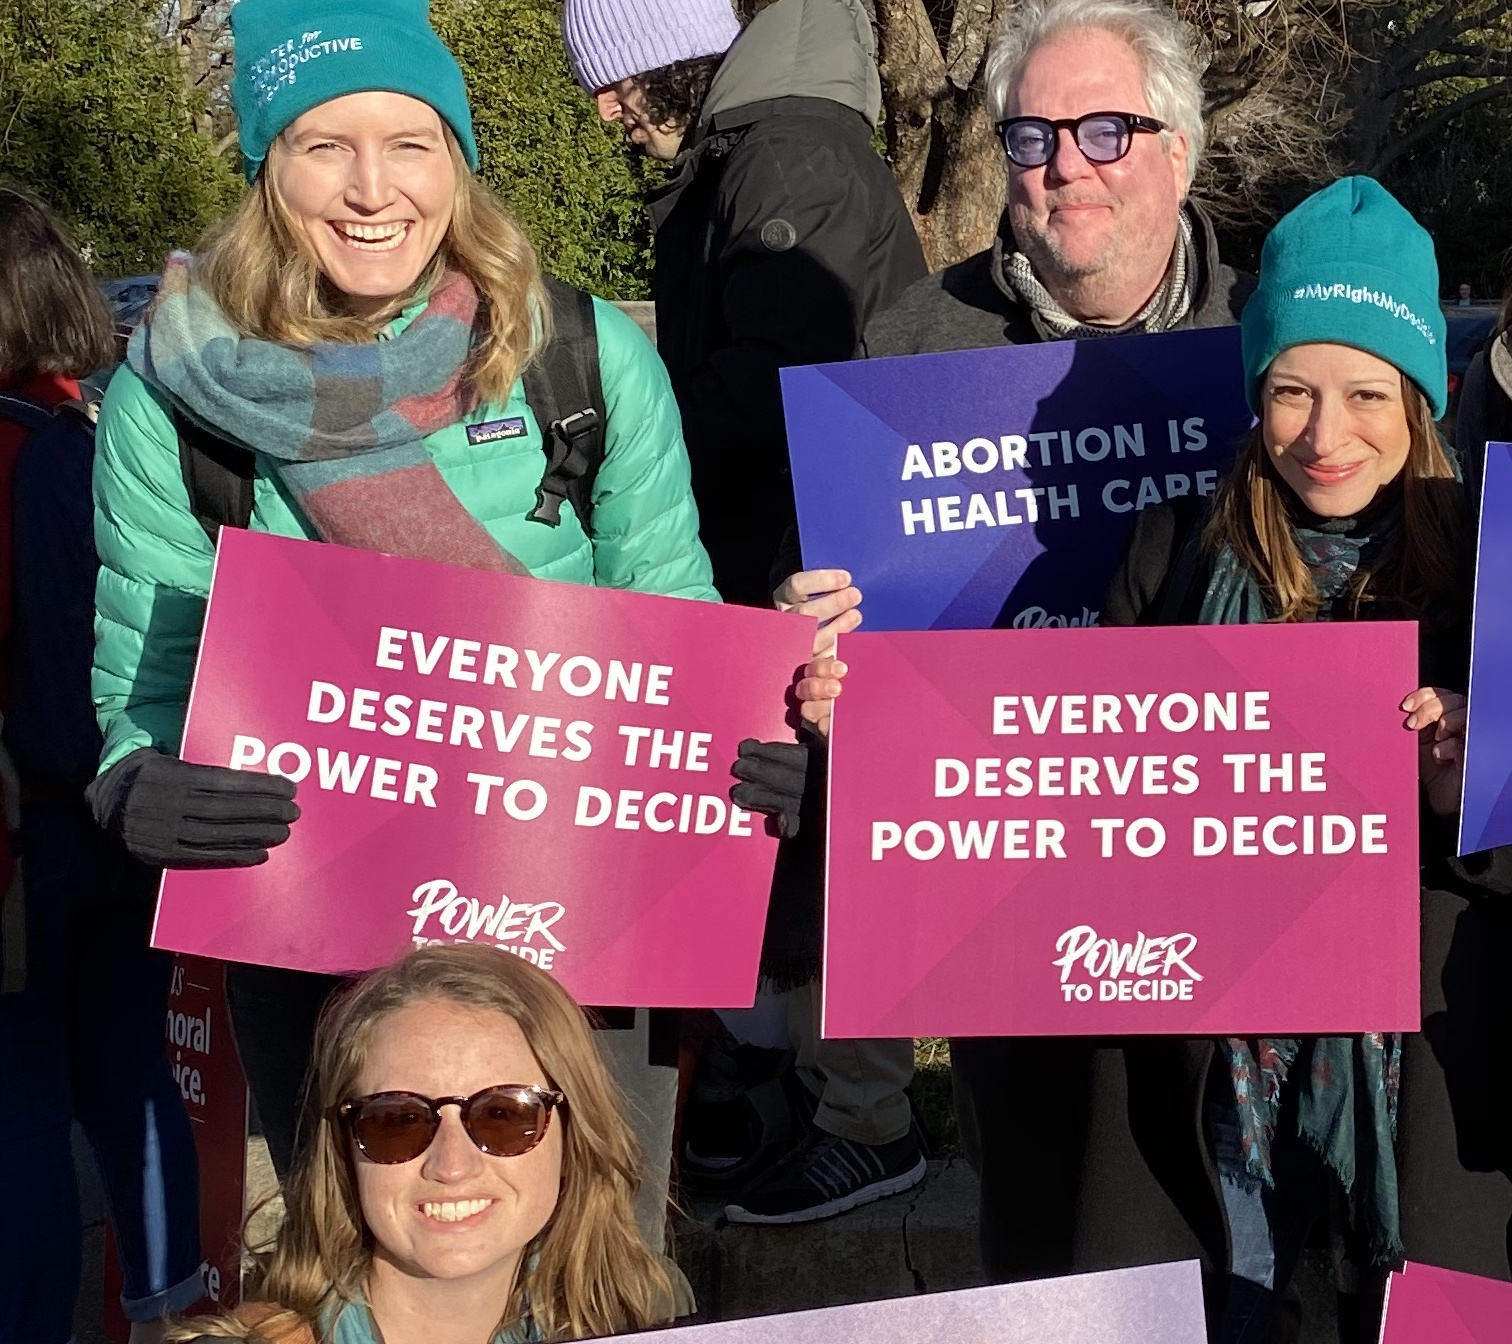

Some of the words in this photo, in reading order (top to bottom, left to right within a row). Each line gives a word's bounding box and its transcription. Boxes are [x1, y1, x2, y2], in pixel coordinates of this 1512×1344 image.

[901, 422, 1146, 481] ABORTION
[1168, 417, 1208, 453] IS
[901, 484, 1081, 536] HEALTH
[1101, 469, 1218, 513] CARE
[375, 626, 674, 706] EVERYONE
[307, 680, 595, 762] DESERVES
[618, 725, 713, 772] THE
[993, 691, 1271, 735] EVERYONE
[229, 734, 438, 808] POWER
[466, 772, 548, 821] TO
[574, 785, 752, 837] DECIDE
[934, 754, 1200, 798] DESERVES
[1222, 752, 1327, 793] THE
[871, 819, 1067, 861] POWER
[1090, 817, 1166, 858] TO
[1193, 814, 1388, 857] DECIDE
[406, 879, 567, 952] POWER
[1051, 925, 1203, 984] POWER
[1060, 983, 1094, 1002] TO
[1099, 979, 1194, 1002] DECIDE
